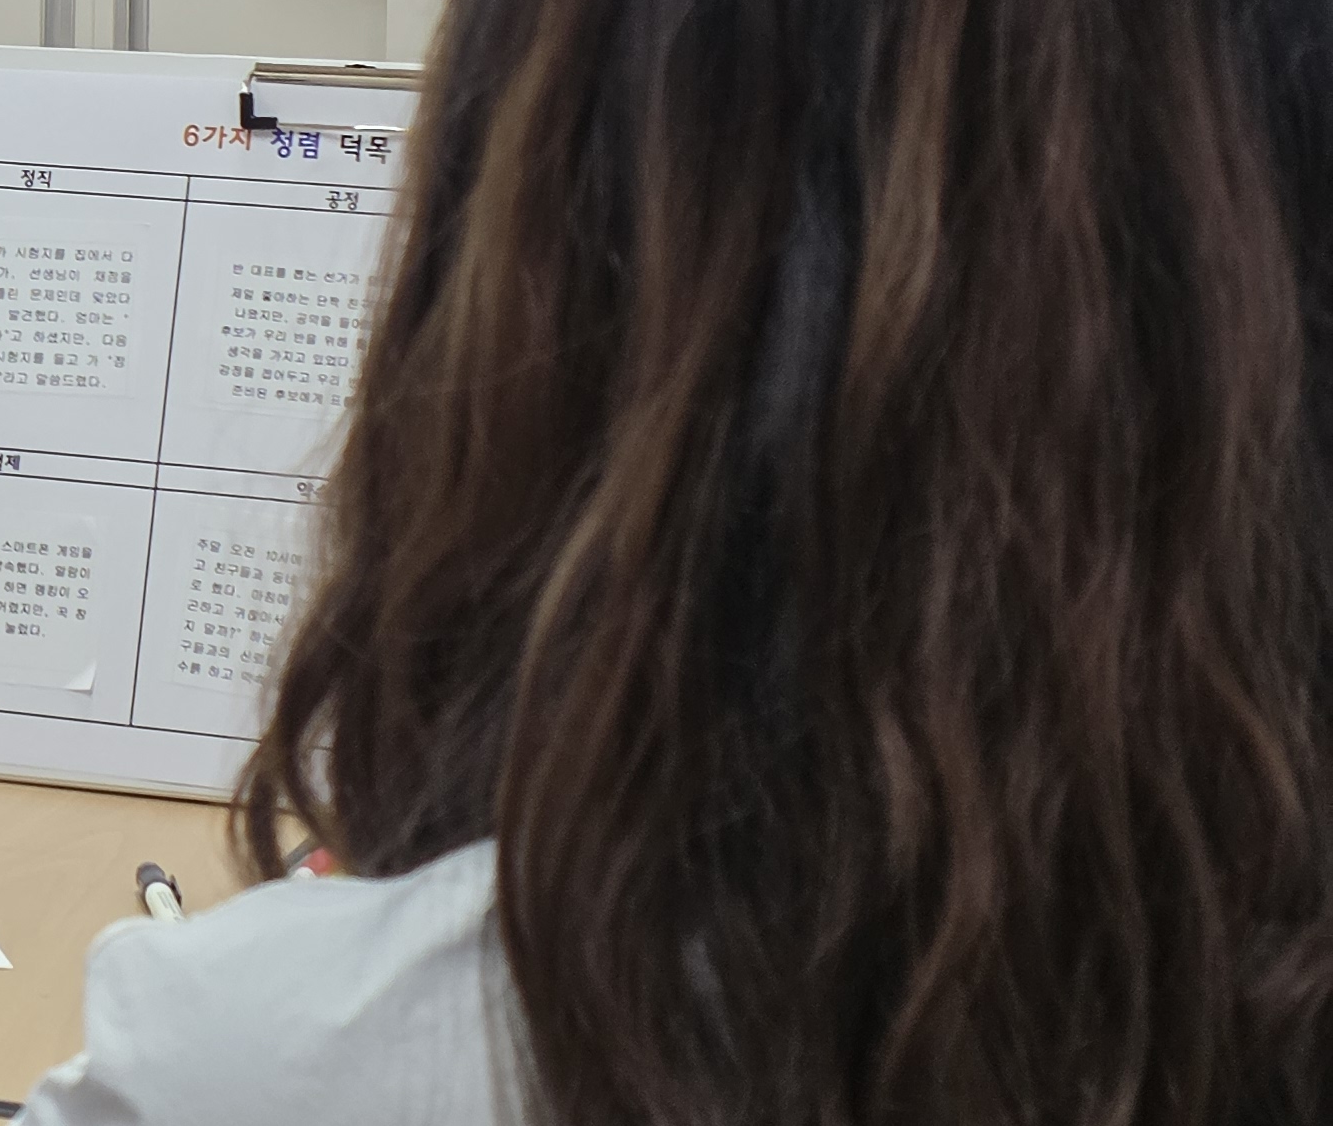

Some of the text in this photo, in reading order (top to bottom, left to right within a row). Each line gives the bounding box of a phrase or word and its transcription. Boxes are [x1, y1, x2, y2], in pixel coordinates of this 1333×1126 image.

[182, 123, 393, 165] 6가지 청렴 덕목
[19, 168, 54, 189] 정직
[325, 190, 360, 212] 공정
